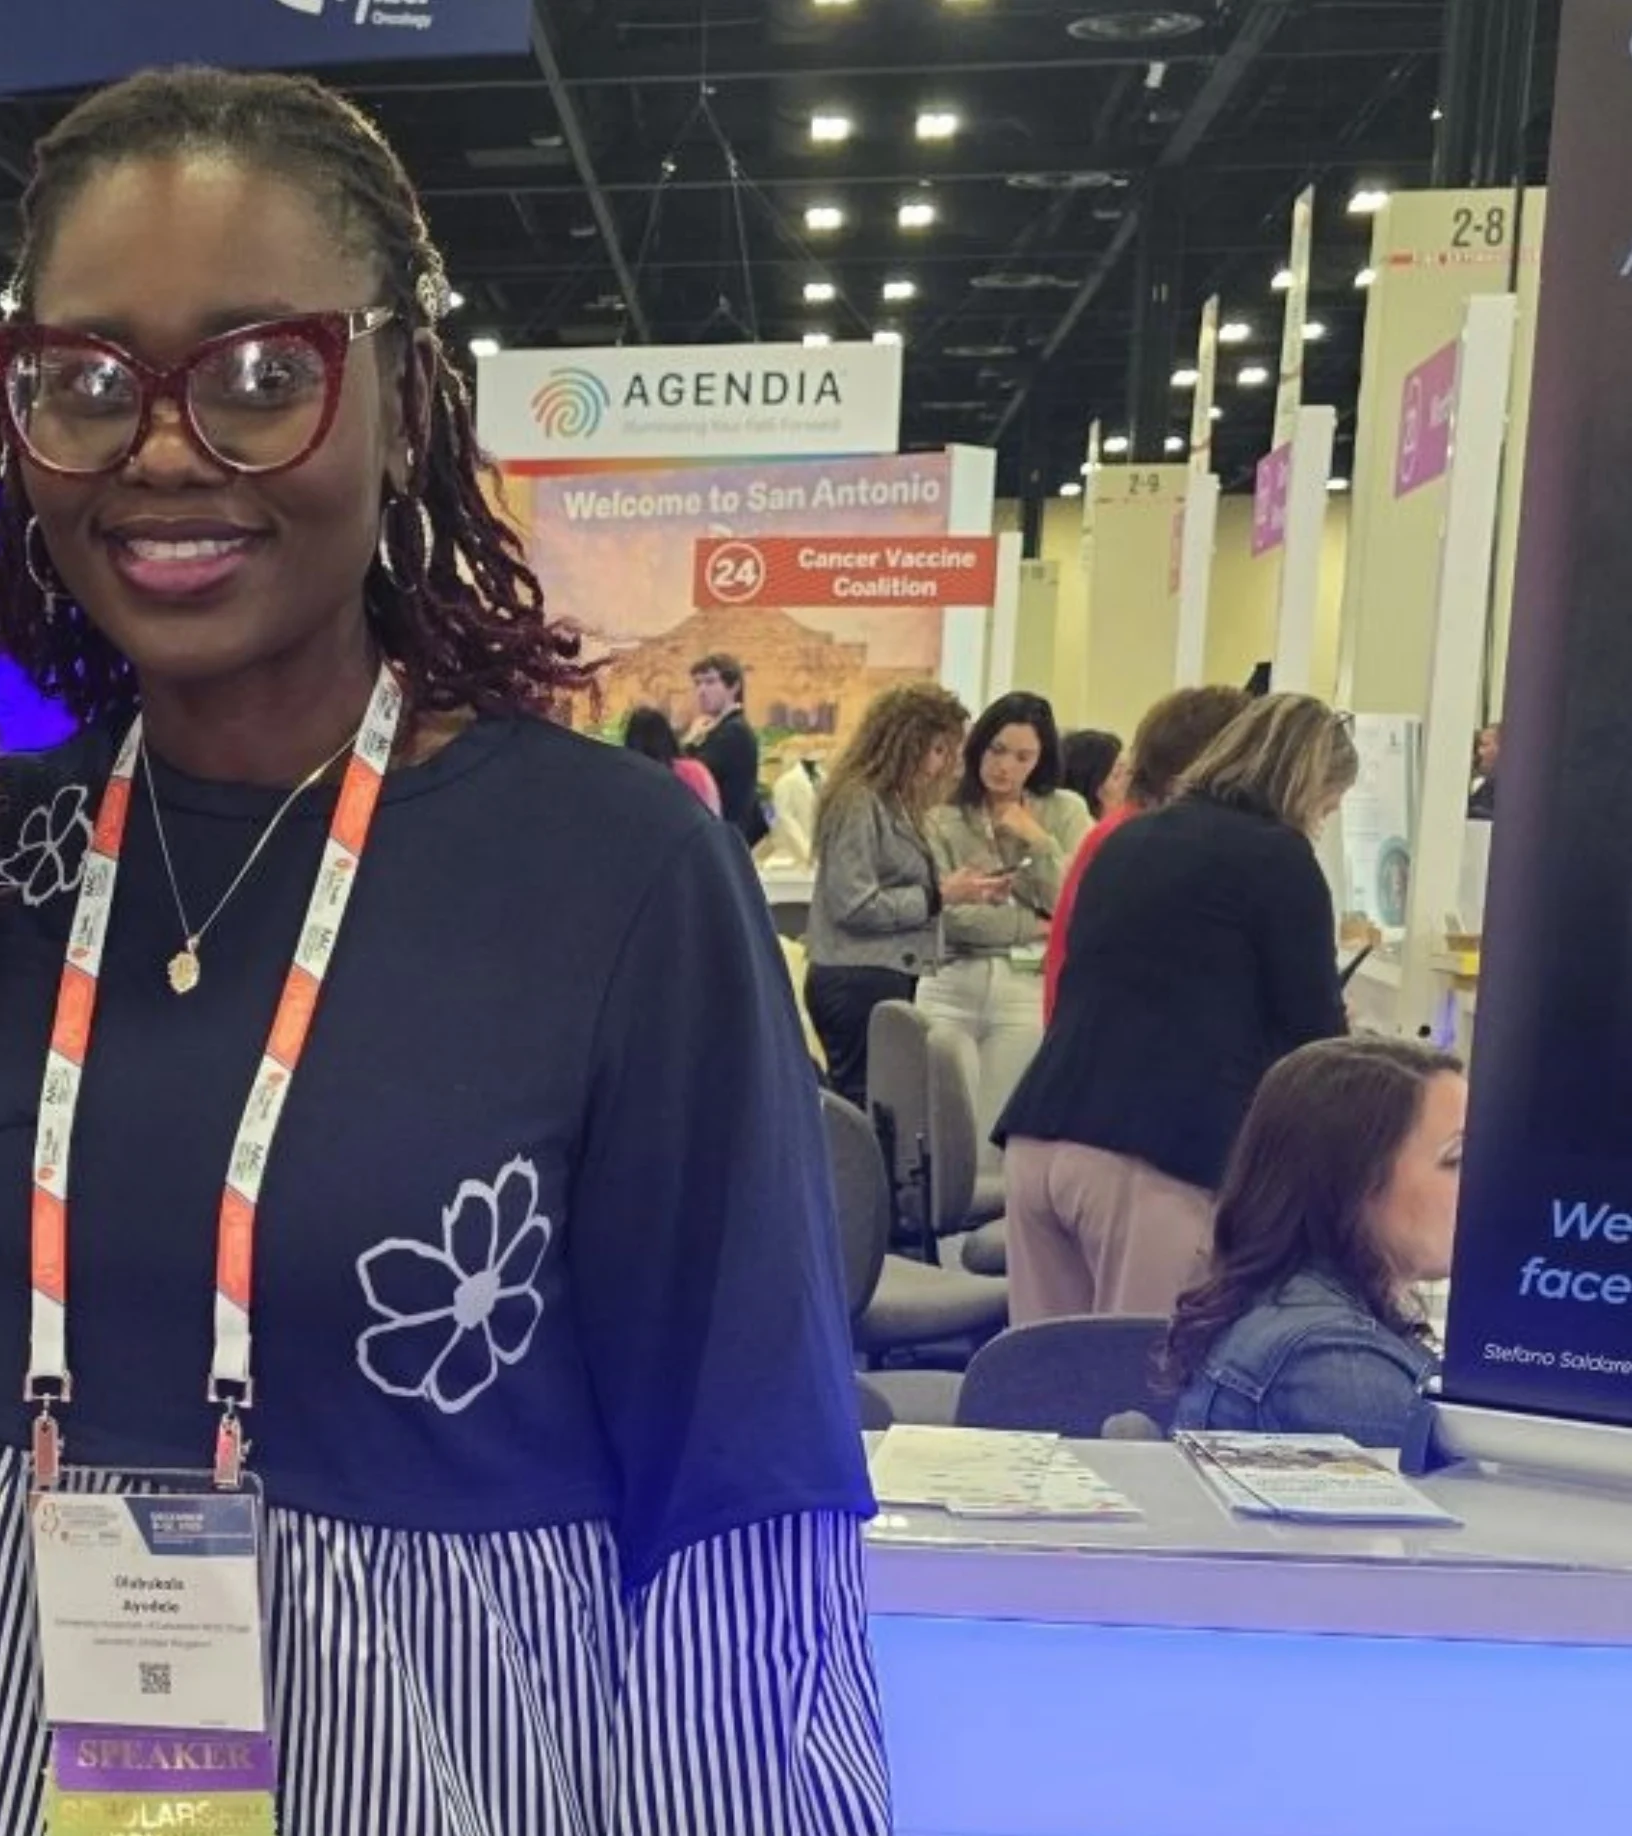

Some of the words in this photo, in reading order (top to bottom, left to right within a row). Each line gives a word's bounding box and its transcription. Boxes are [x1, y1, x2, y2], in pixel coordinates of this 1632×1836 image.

[1451, 207, 1505, 248] 2-8
[623, 370, 843, 408] AGENDIA
[564, 490, 702, 521] Welcome
[710, 484, 738, 514] to
[747, 481, 807, 513] San
[811, 474, 941, 509] Antonio
[713, 559, 759, 587] 24
[798, 548, 878, 570] Cancer
[885, 546, 977, 569] Vaccine
[832, 575, 938, 598] Coalition
[1551, 1198, 1632, 1244] We
[1519, 1256, 1632, 1305] face
[1483, 1342, 1556, 1367] Stefano
[76, 1738, 255, 1771] SPEAKER
